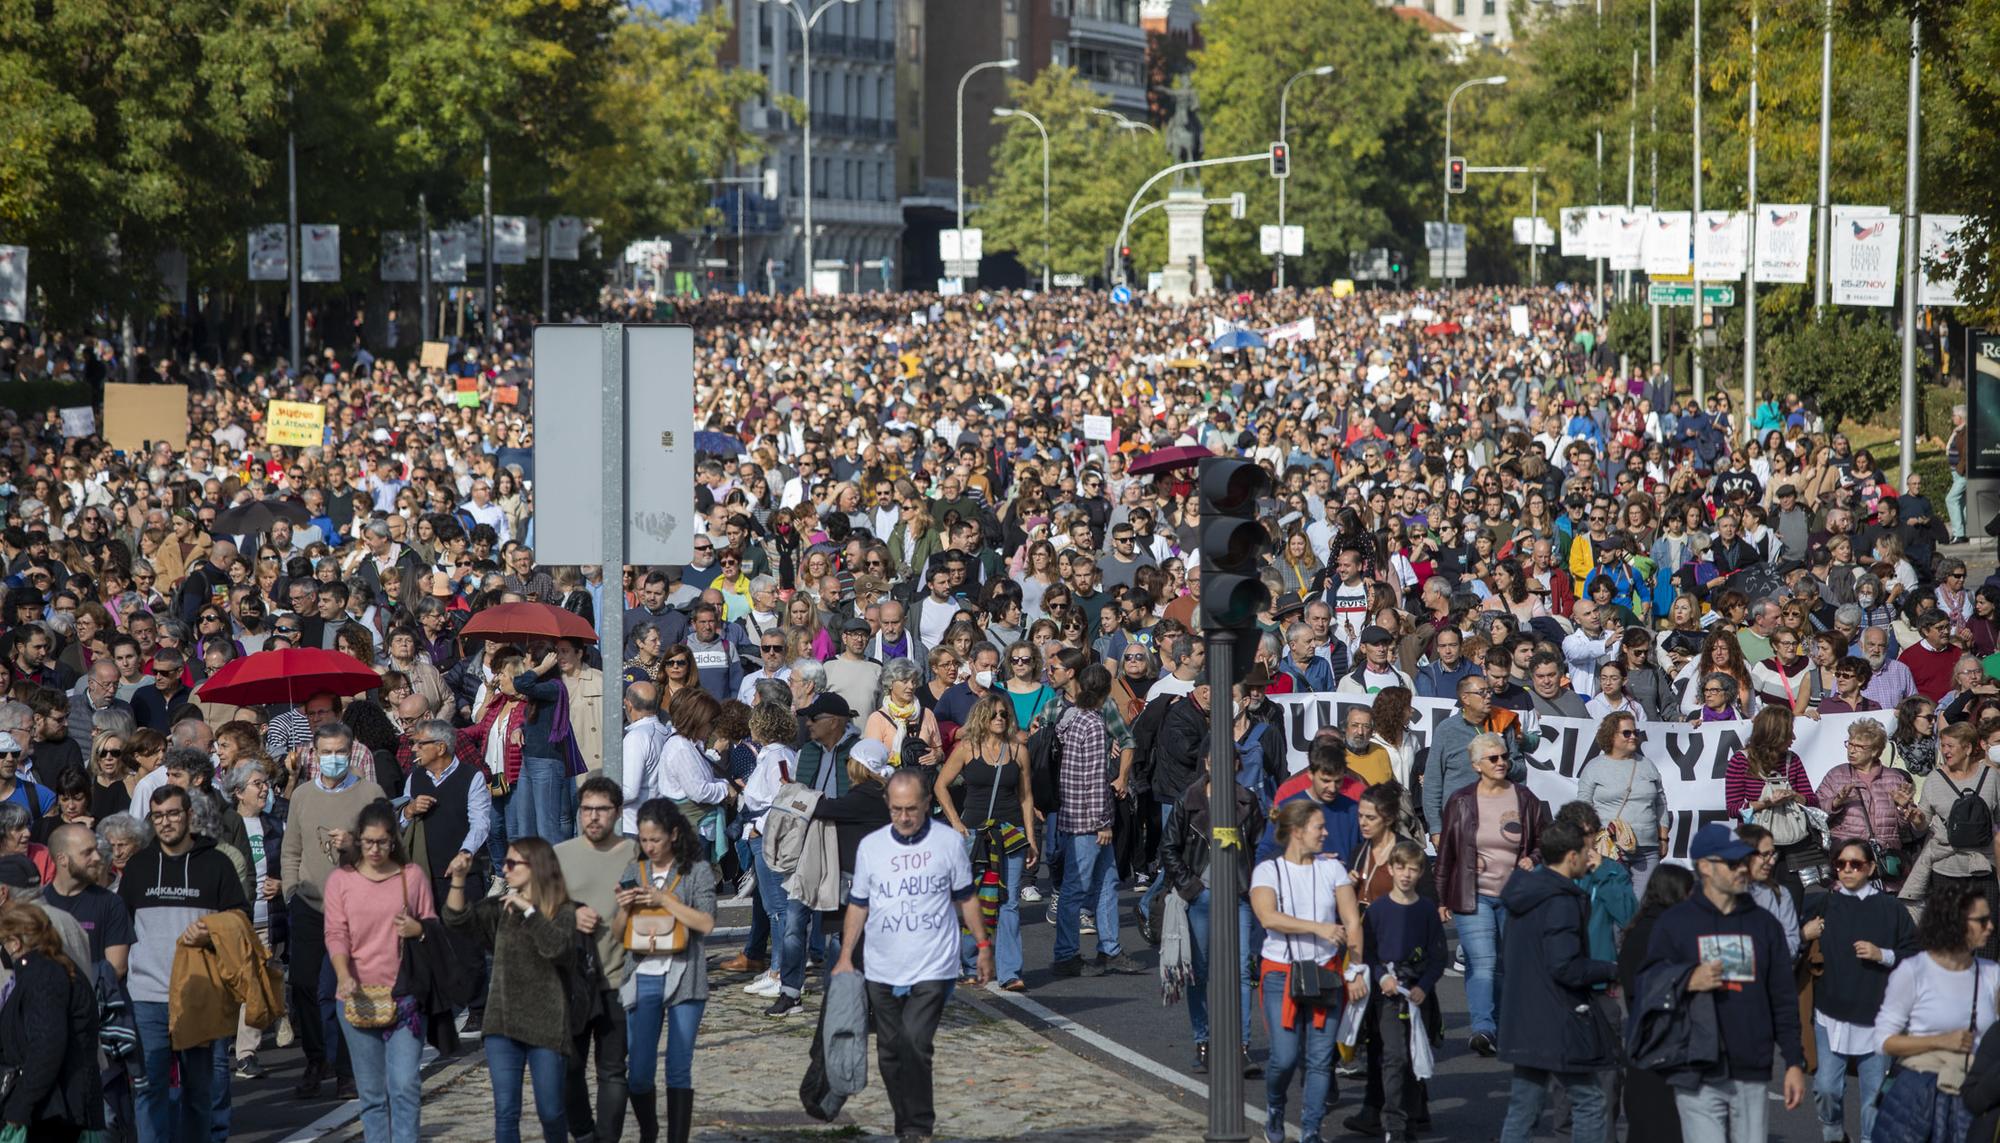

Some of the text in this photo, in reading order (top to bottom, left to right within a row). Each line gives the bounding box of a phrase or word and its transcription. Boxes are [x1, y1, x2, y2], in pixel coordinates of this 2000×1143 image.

[1722, 478, 1753, 496] NYC
[695, 653, 722, 664] didas
[890, 850, 932, 873] STOP
[880, 880, 894, 898] AL
[901, 899, 918, 916] DE
[881, 912, 943, 934] AYUSO
